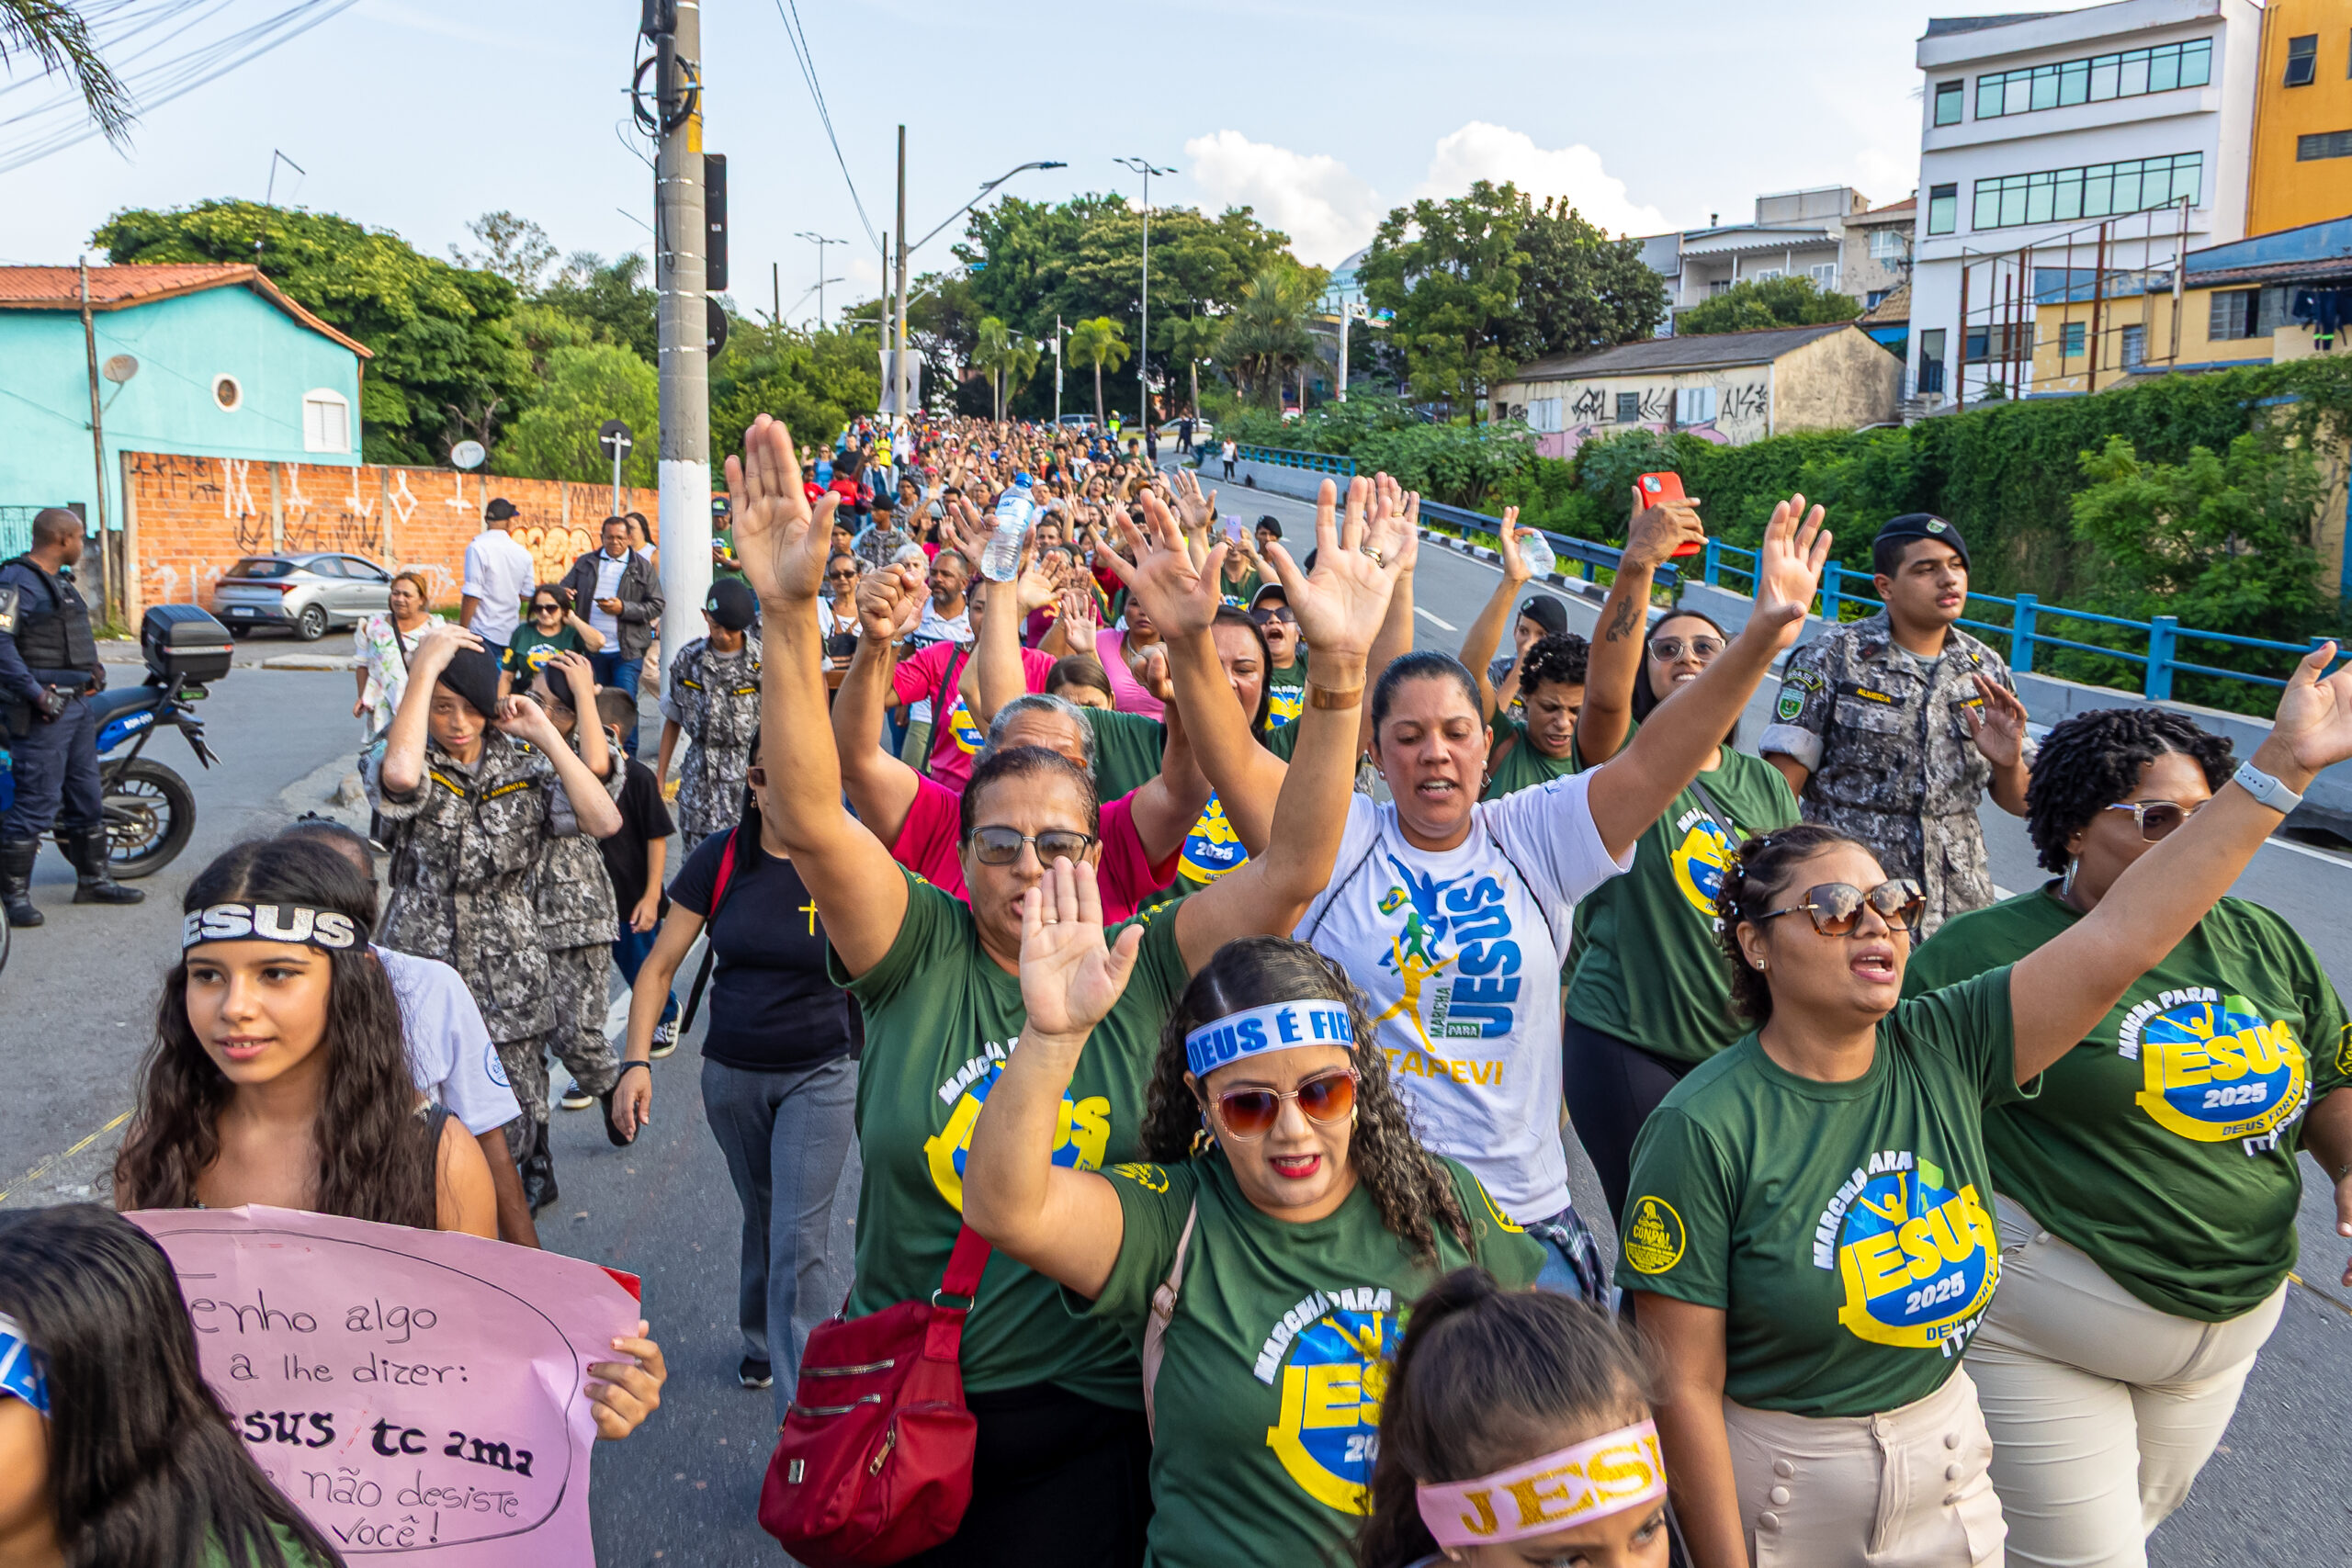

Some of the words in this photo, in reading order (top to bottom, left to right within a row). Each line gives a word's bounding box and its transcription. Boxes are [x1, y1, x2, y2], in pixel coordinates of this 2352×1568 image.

[1445, 875, 1522, 1039] JESUS
[2157, 986, 2219, 1010] PARA
[1276, 1007, 1303, 1044] É
[1448, 1025, 1478, 1037] PARA
[1382, 1048, 1504, 1087] TAPEVI
[2202, 1081, 2267, 1110] 2025
[2222, 1118, 2266, 1136] DEUS
[1813, 1167, 1869, 1270] MARCHA
[1868, 1150, 1914, 1175] ARA
[1905, 1270, 1966, 1315] 2025
[189, 1288, 317, 1334] enho
[345, 1297, 437, 1344] algo
[1253, 1289, 1330, 1386] MARCHA
[230, 1353, 260, 1381] a
[283, 1352, 334, 1382] lhe
[243, 1410, 337, 1449] sus
[444, 1430, 534, 1479] ama
[301, 1467, 382, 1507] não
[397, 1470, 520, 1518] desiste
